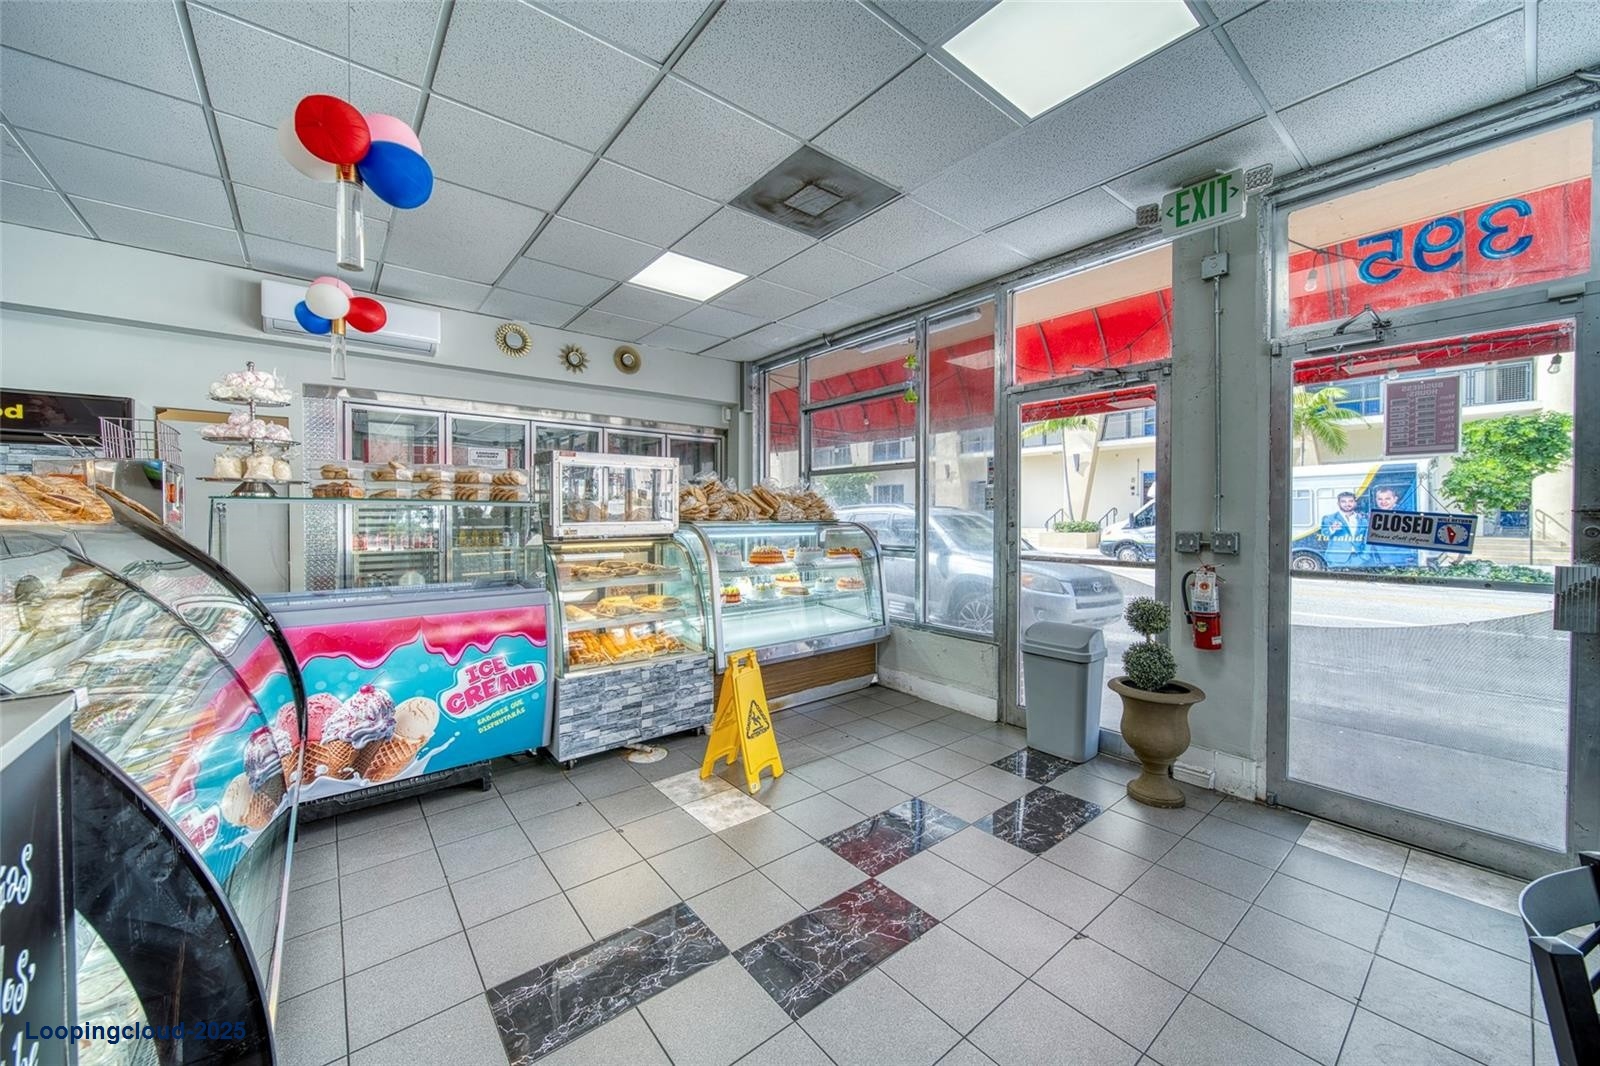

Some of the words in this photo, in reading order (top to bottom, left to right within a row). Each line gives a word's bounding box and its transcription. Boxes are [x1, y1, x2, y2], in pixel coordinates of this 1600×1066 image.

[1175, 174, 1232, 228] EXIT
[1371, 513, 1434, 535] CLOSED
[465, 656, 507, 685] ICE
[446, 665, 538, 715] CREAM
[477, 706, 509, 725] SABORES
[511, 698, 525, 709] QUE
